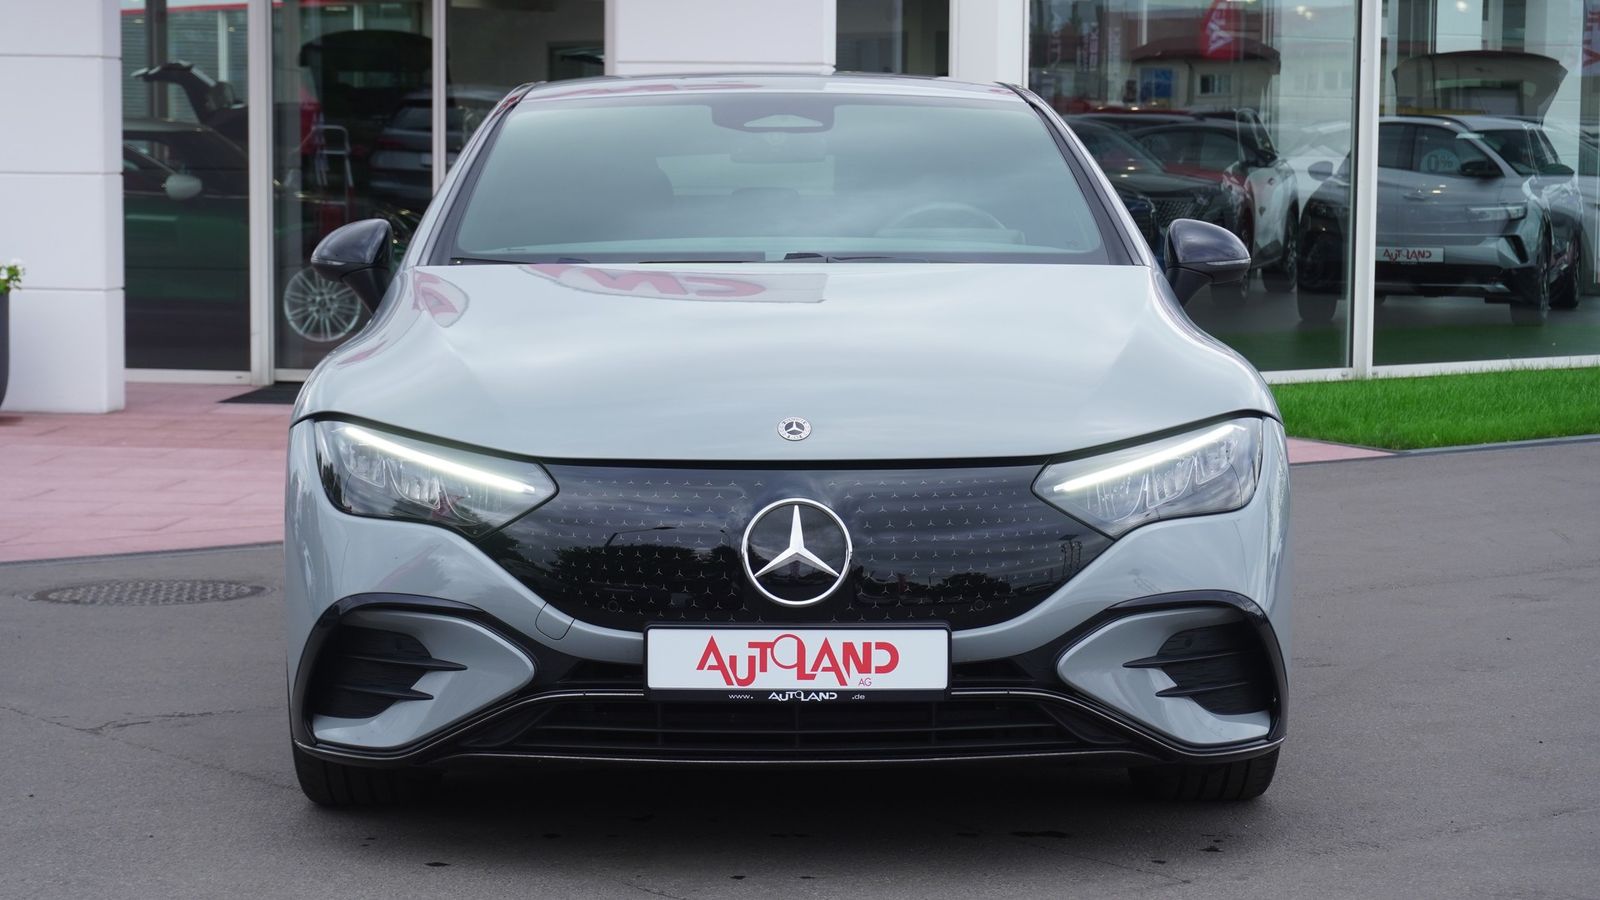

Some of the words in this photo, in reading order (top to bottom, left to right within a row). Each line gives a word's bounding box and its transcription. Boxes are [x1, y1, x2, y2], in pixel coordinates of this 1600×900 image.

[1383, 247, 1432, 262] AUTOLAND
[696, 634, 900, 687] AUTOLAND
[858, 678, 872, 687] AG
[768, 691, 838, 701] AUTOLAND
